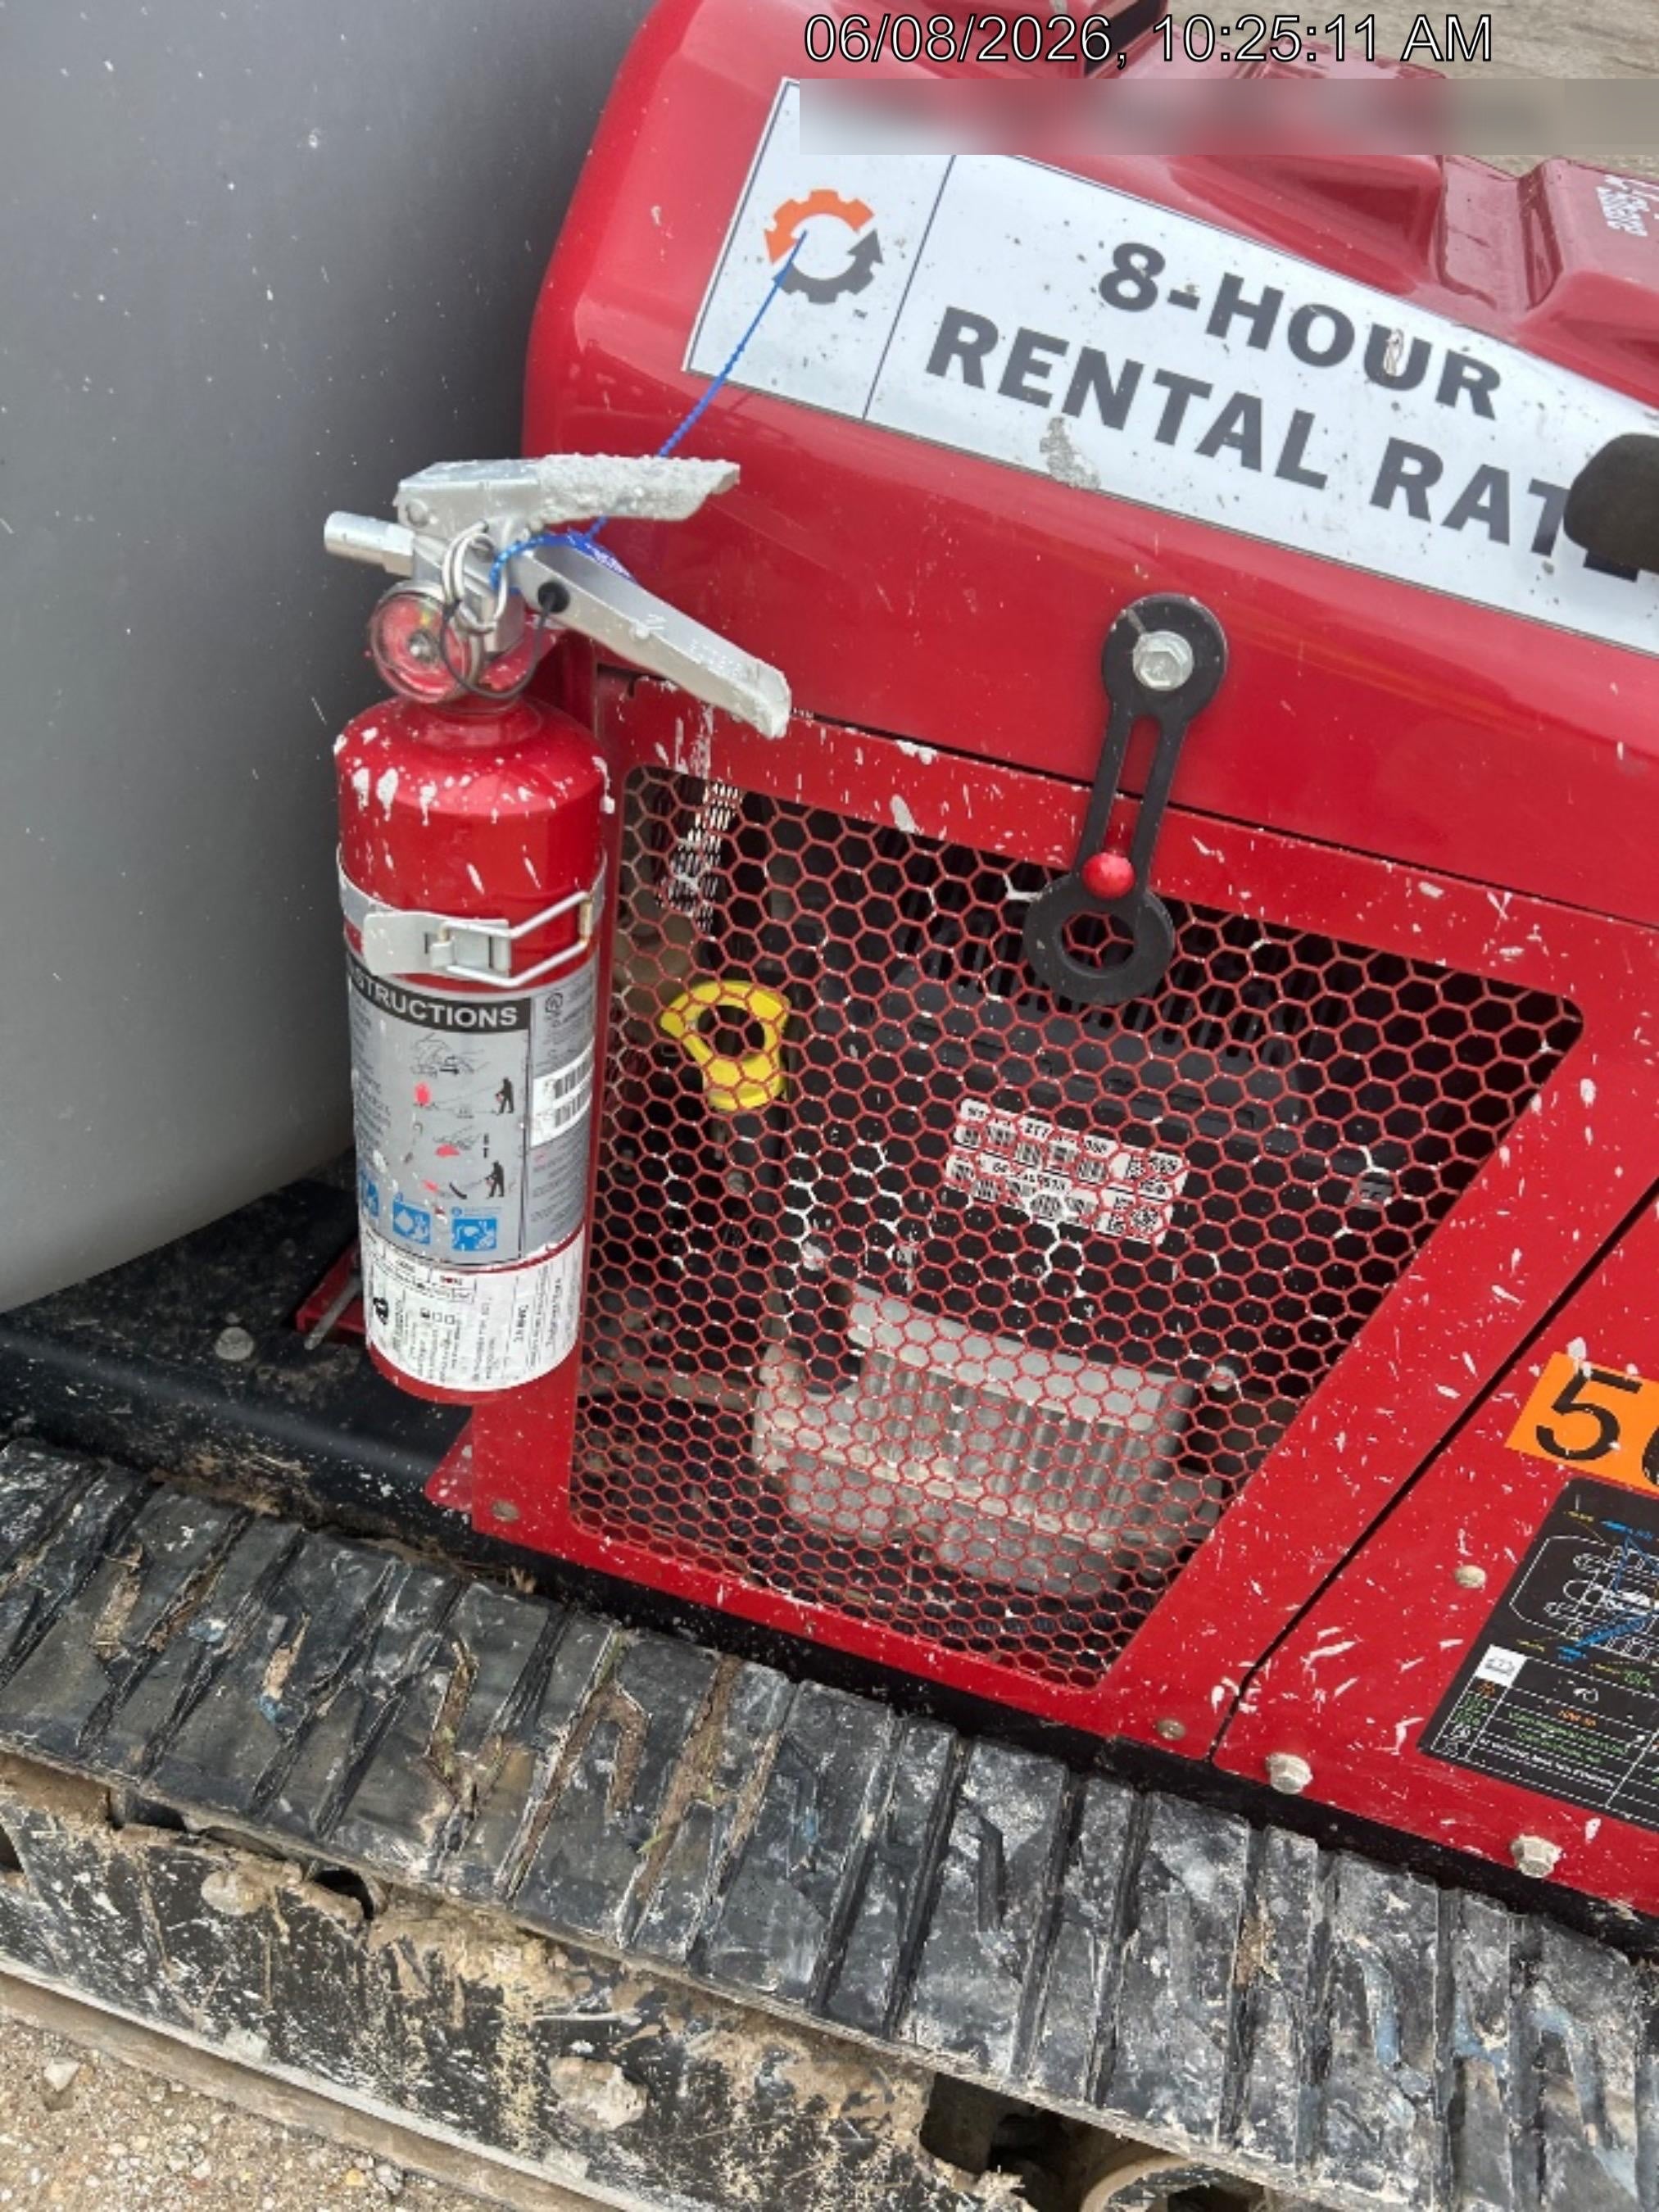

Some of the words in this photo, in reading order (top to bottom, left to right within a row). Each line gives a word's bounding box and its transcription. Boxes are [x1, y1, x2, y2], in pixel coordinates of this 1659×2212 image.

[926, 306, 1328, 490] RENTAL
[1370, 437, 1639, 583] RAT
[1098, 243, 1501, 420] 8-HOUR
